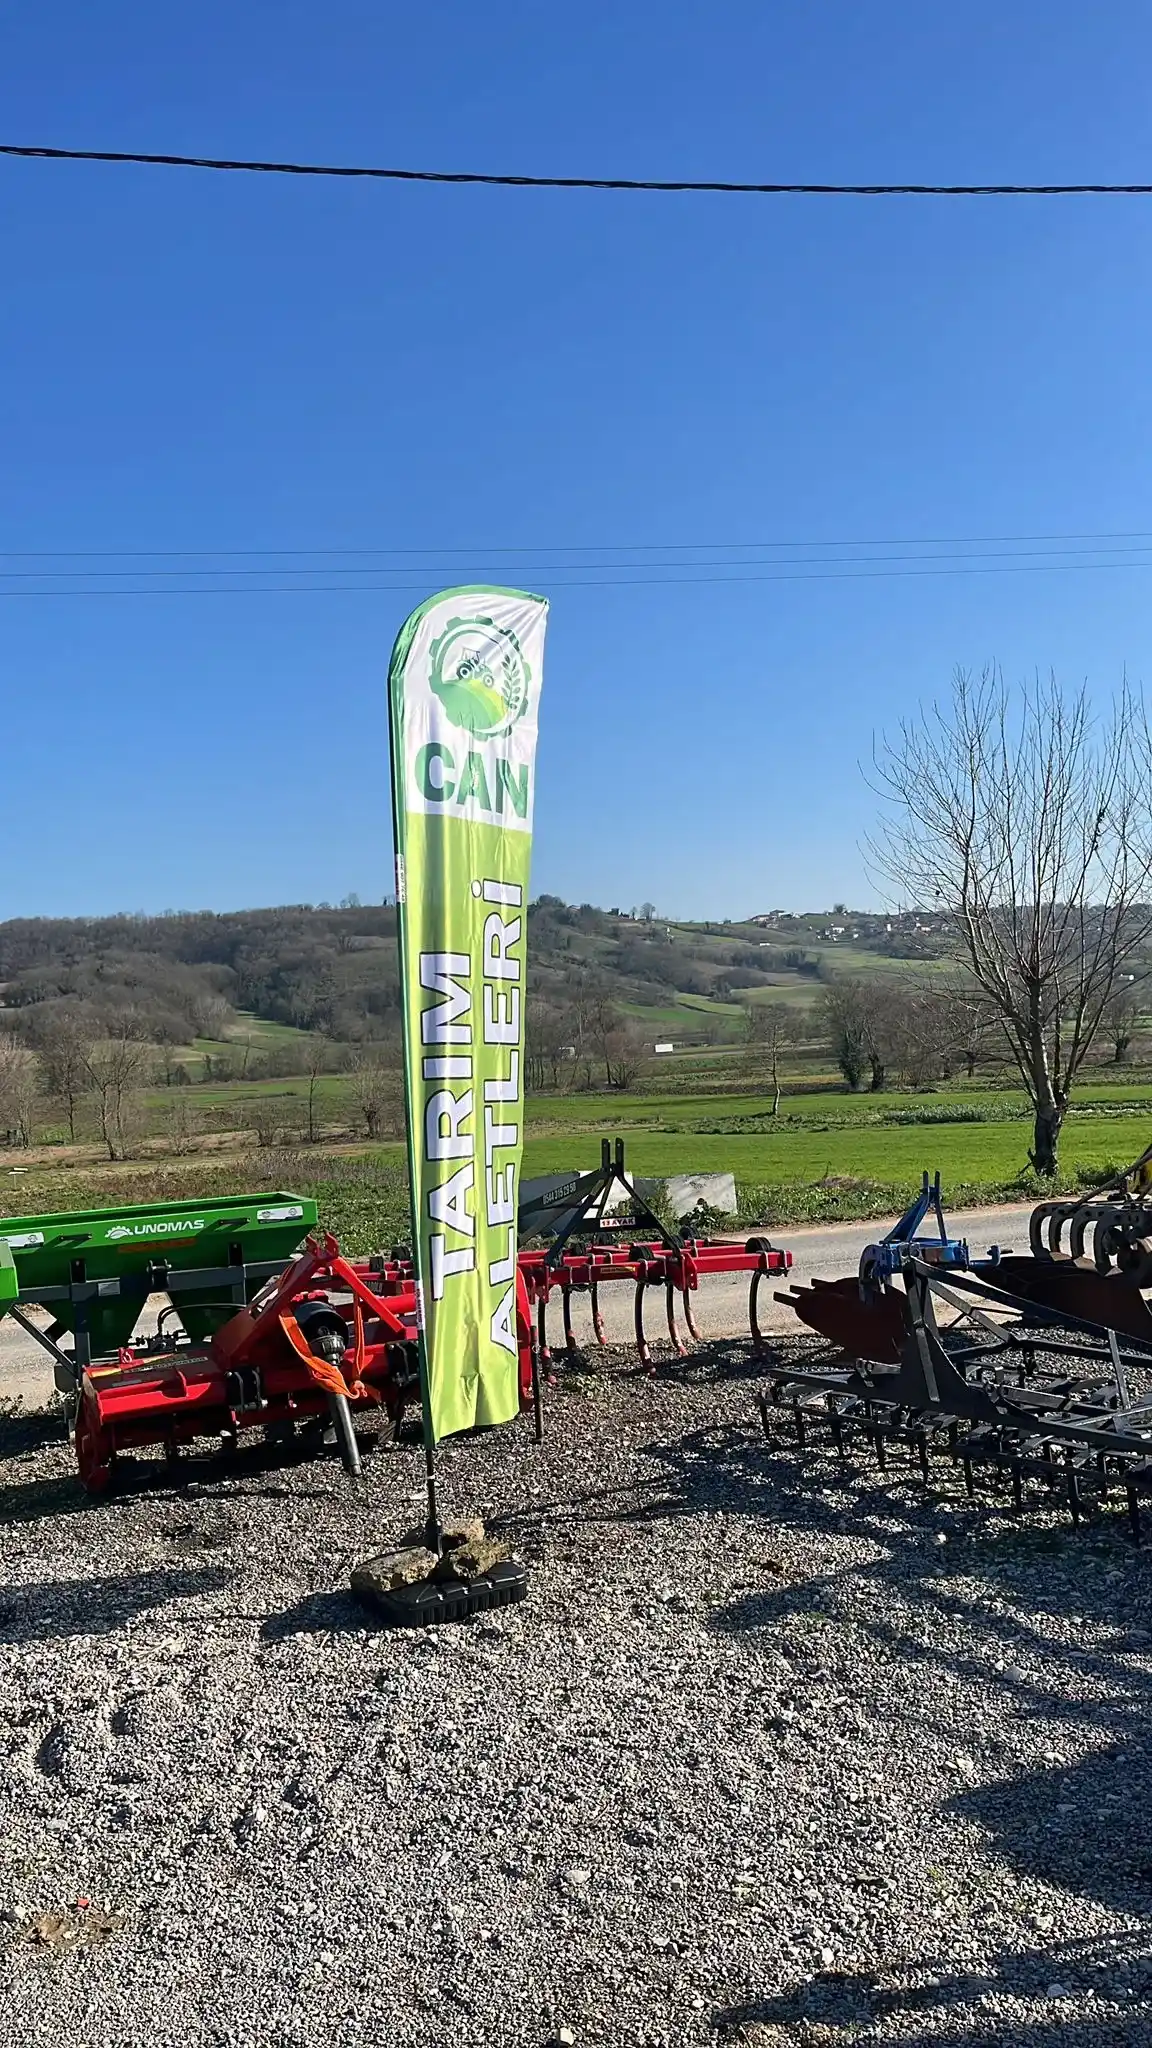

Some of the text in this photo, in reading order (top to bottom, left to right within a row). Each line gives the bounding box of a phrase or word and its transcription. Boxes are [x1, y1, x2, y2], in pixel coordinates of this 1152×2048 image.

[414, 742, 529, 819] CAN
[419, 951, 475, 1300] TARIM
[471, 878, 524, 1355] ALETLERİ
[134, 1219, 205, 1235] UNOMAS
